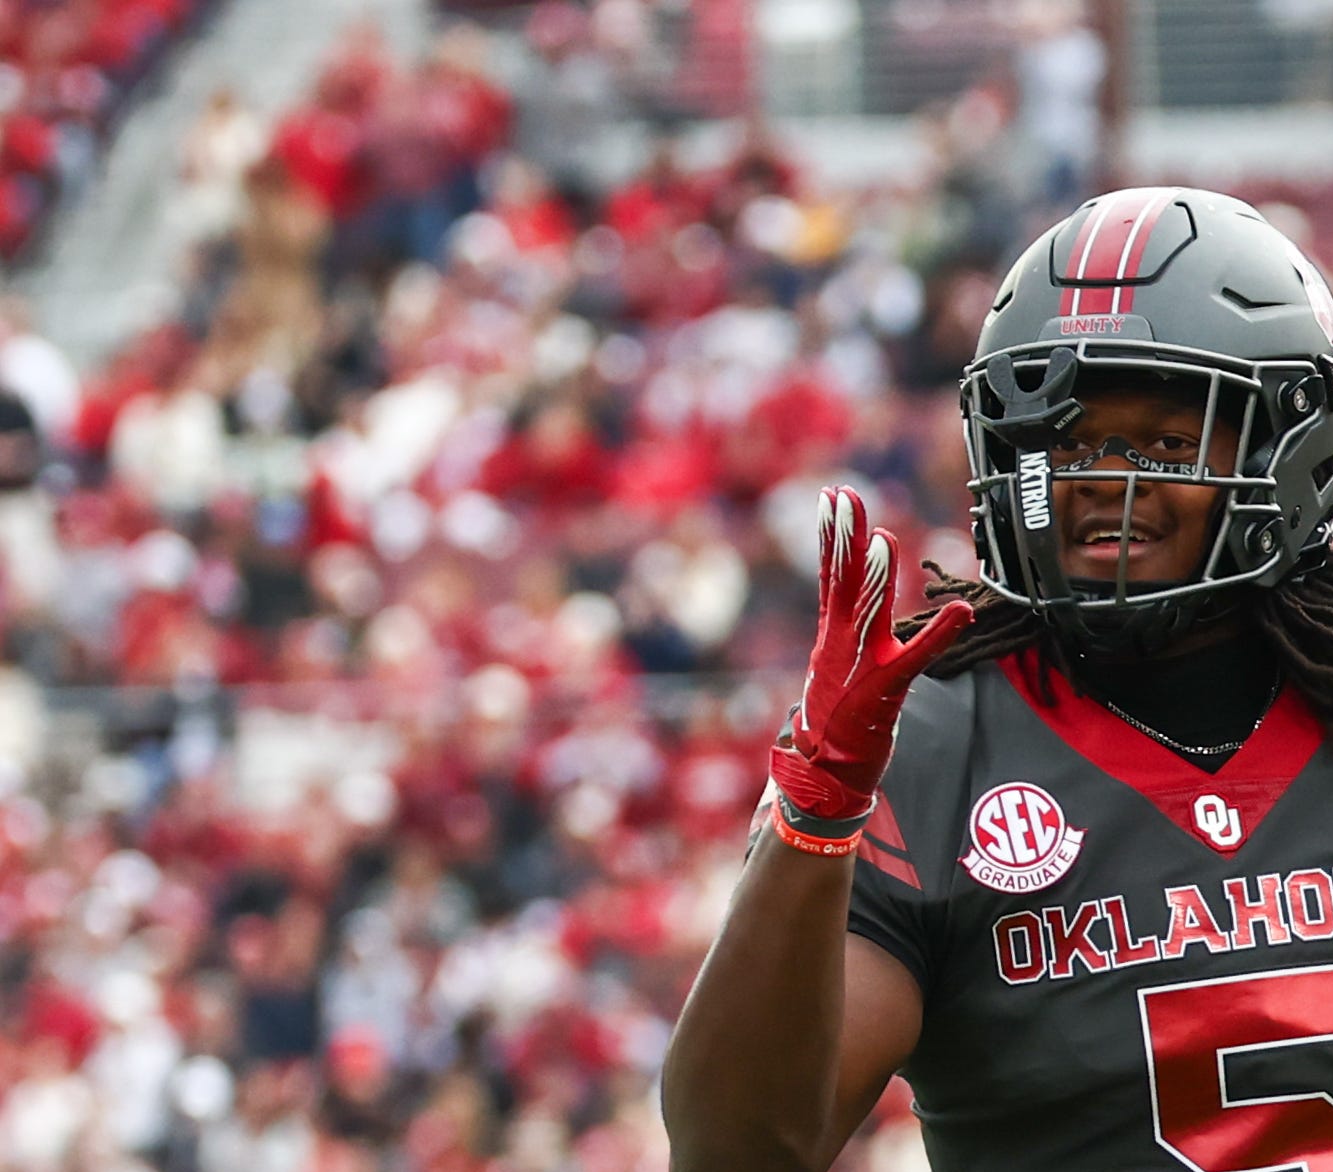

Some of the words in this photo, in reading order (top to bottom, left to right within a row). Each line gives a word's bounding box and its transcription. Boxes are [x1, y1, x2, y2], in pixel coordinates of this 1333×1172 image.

[1061, 317, 1125, 335] UNITY
[1020, 451, 1050, 531] NXTRND
[978, 789, 1058, 865] SEC
[1194, 794, 1242, 846] OU
[978, 849, 1074, 890] GRADUATE
